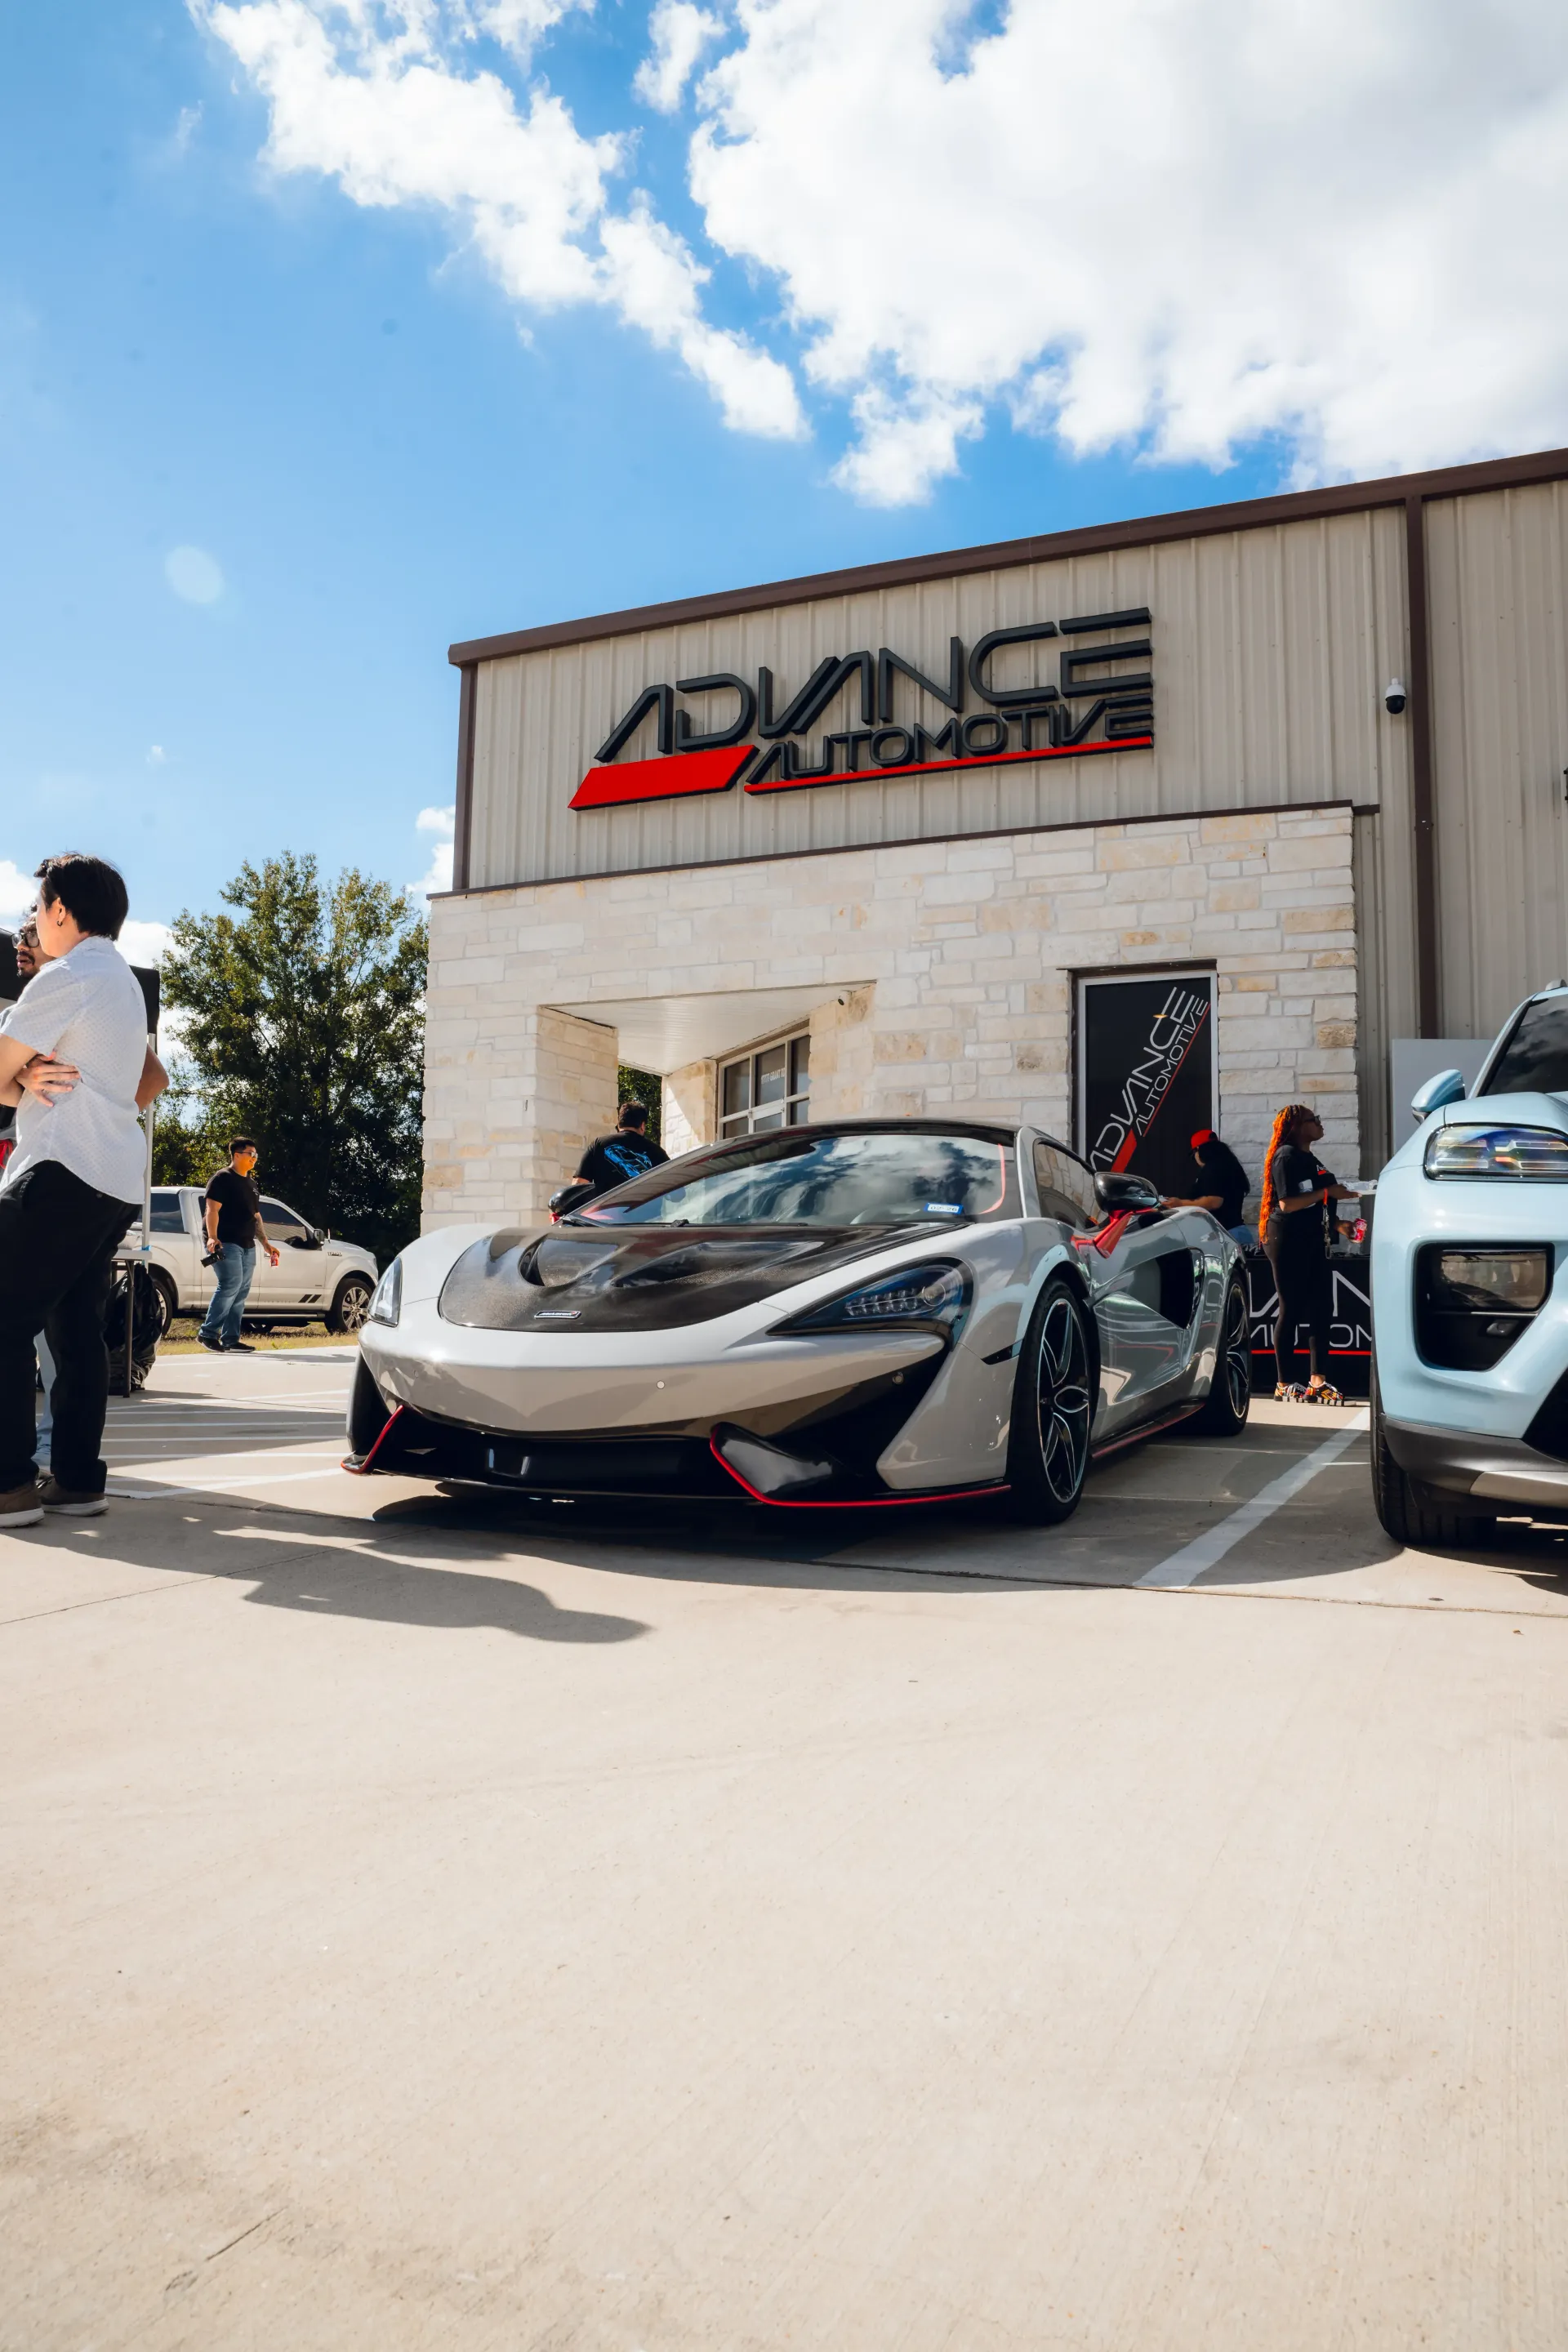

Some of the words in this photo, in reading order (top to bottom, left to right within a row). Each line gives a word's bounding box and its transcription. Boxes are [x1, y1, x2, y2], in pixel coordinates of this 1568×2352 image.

[594, 607, 1152, 762] ADVANCE
[745, 694, 1153, 786] AUTOMOTIVE
[1089, 987, 1195, 1173] ADVANCE
[1135, 997, 1209, 1137] AUTOMOTIVE
